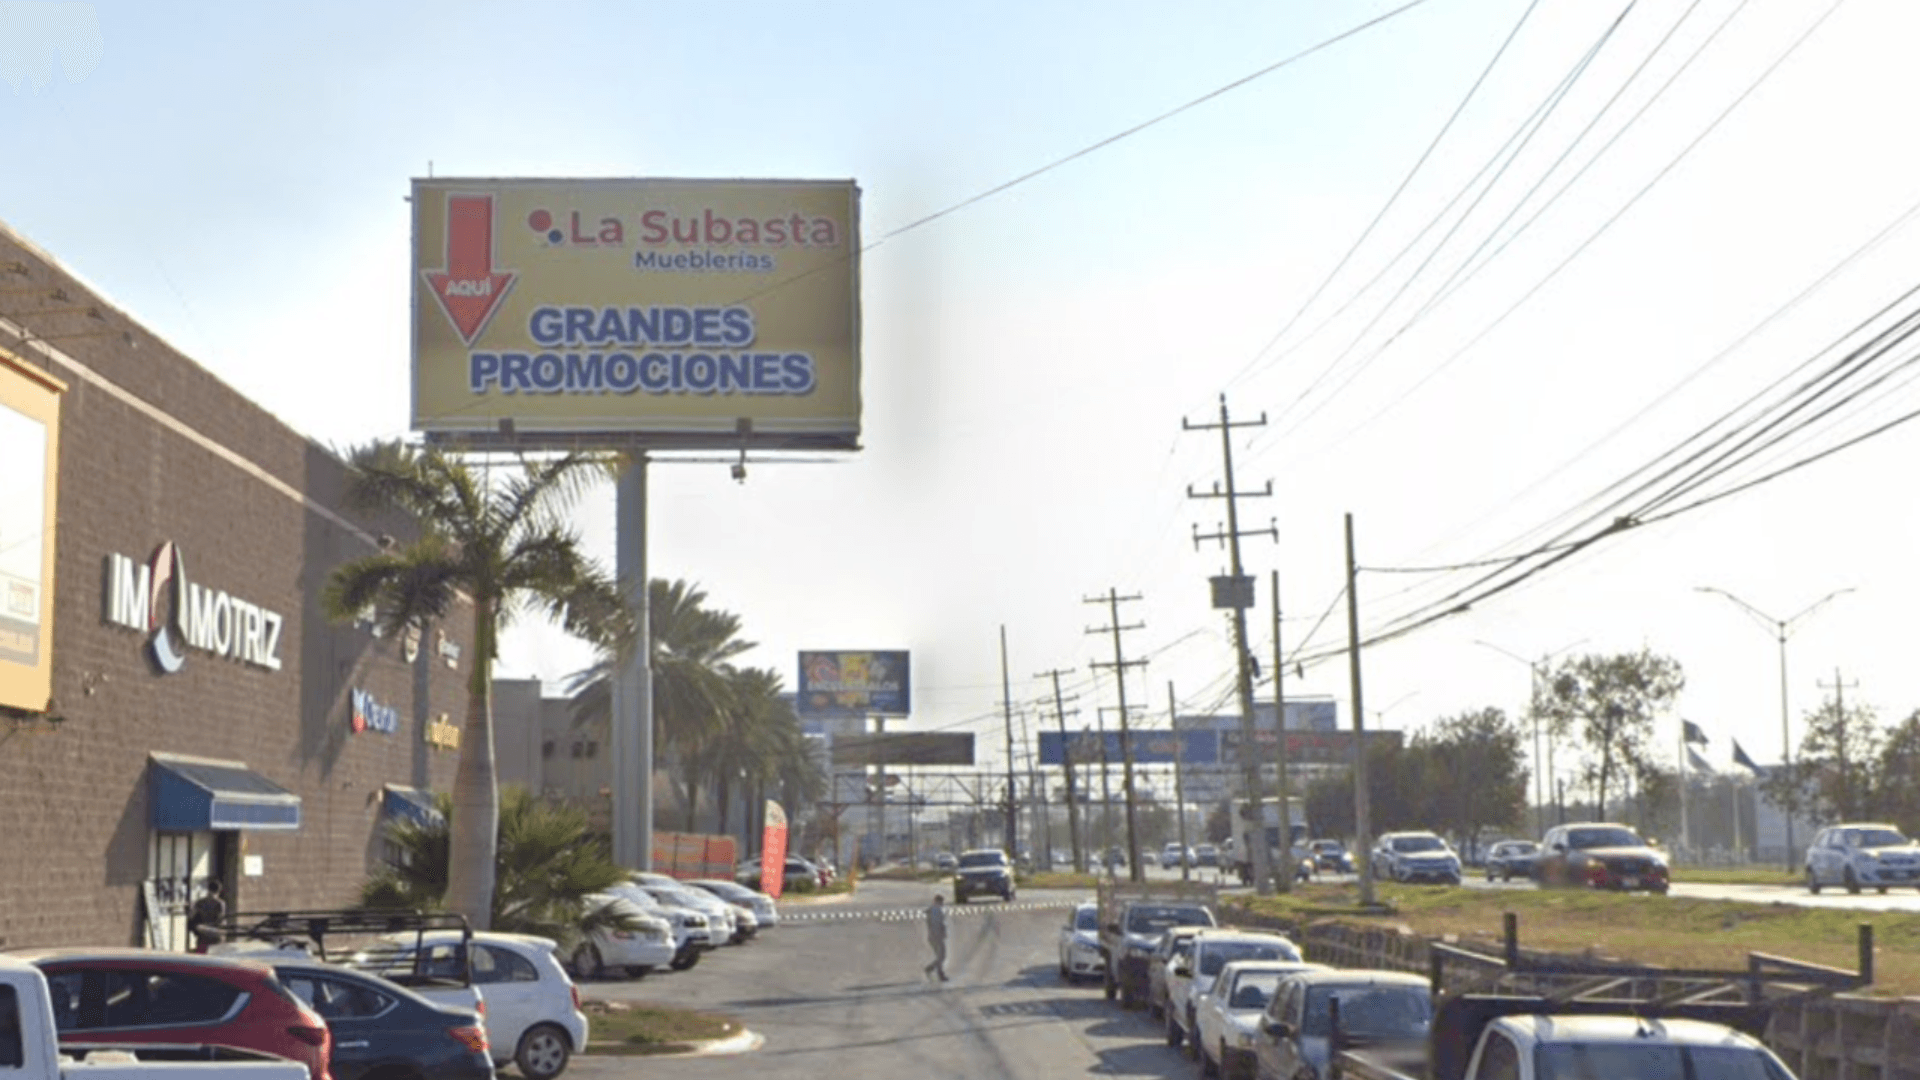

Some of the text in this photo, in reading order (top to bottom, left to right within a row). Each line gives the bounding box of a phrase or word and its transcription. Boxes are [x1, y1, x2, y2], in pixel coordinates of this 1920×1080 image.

[570, 209, 837, 246] La Subasta
[634, 250, 774, 269] Mueblerías
[530, 306, 754, 345] GRANDES
[470, 351, 814, 392] PROMOCIONES
